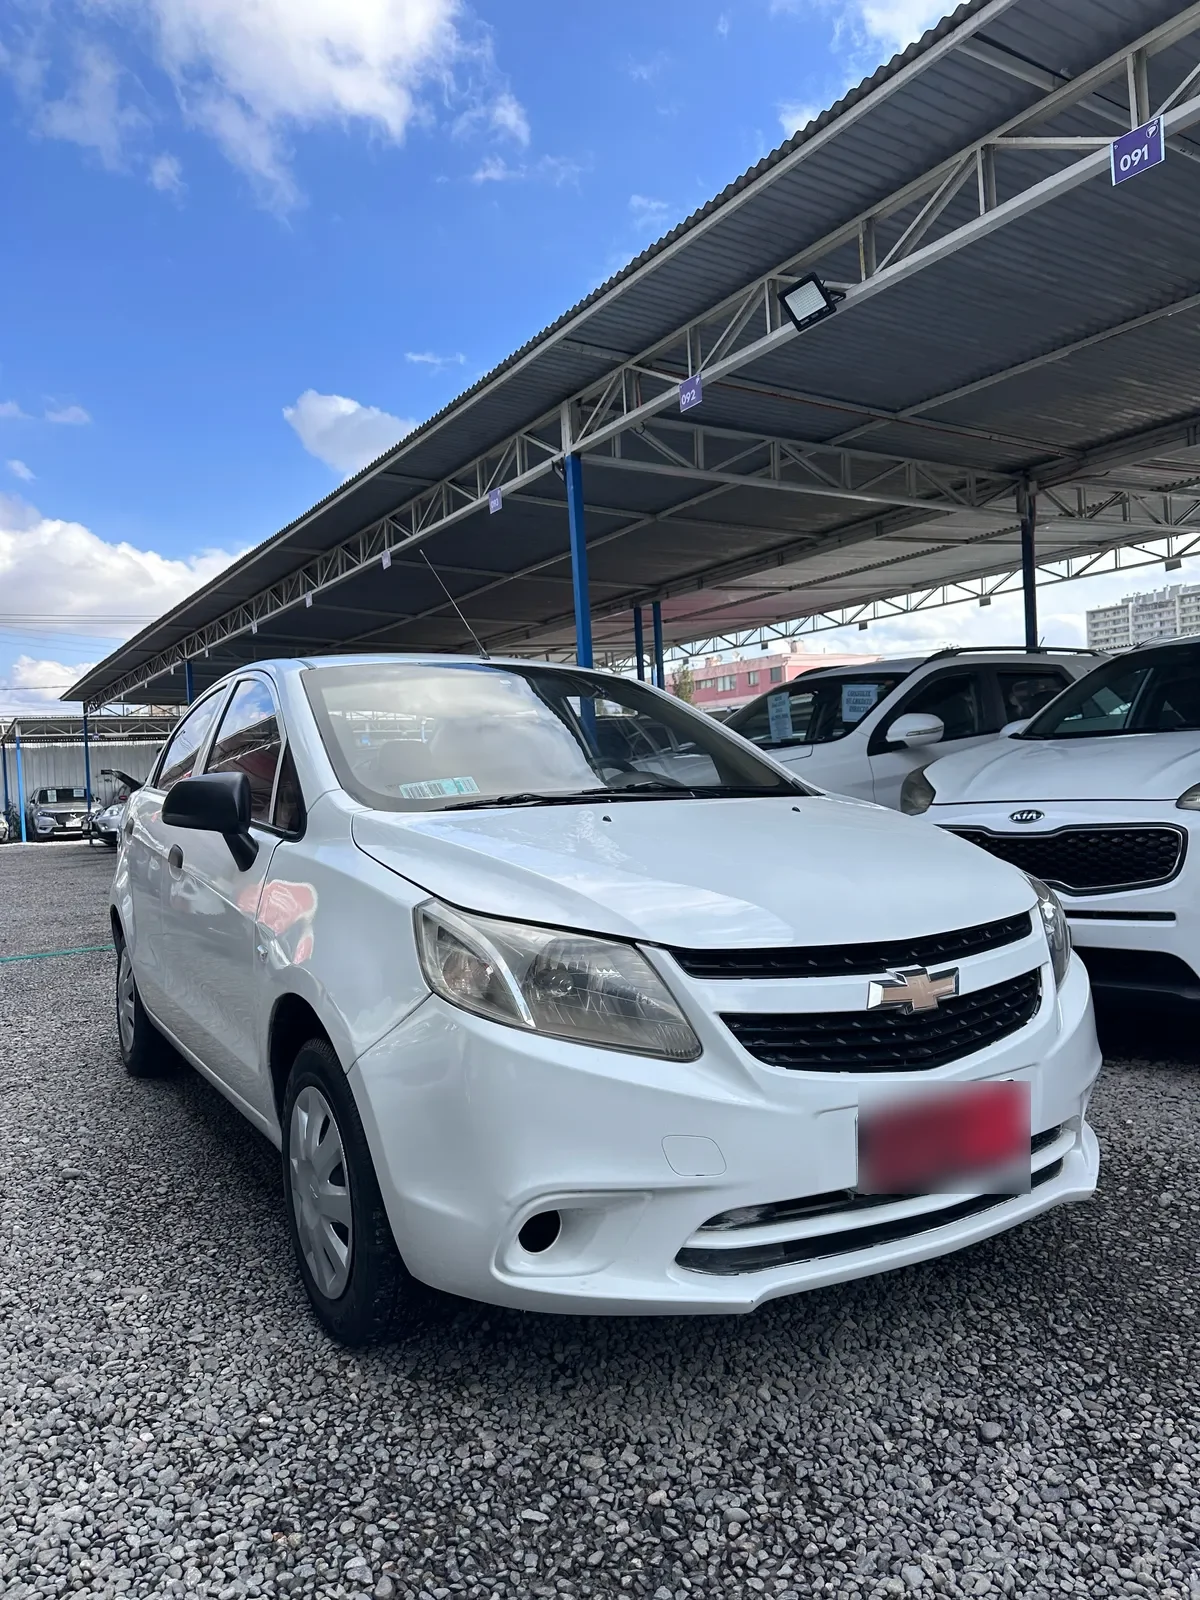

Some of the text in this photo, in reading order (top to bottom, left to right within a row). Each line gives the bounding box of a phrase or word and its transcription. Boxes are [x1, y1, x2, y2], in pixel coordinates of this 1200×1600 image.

[1120, 144, 1148, 171] 091
[681, 389, 696, 405] 092
[1012, 811, 1037, 820] KIA
